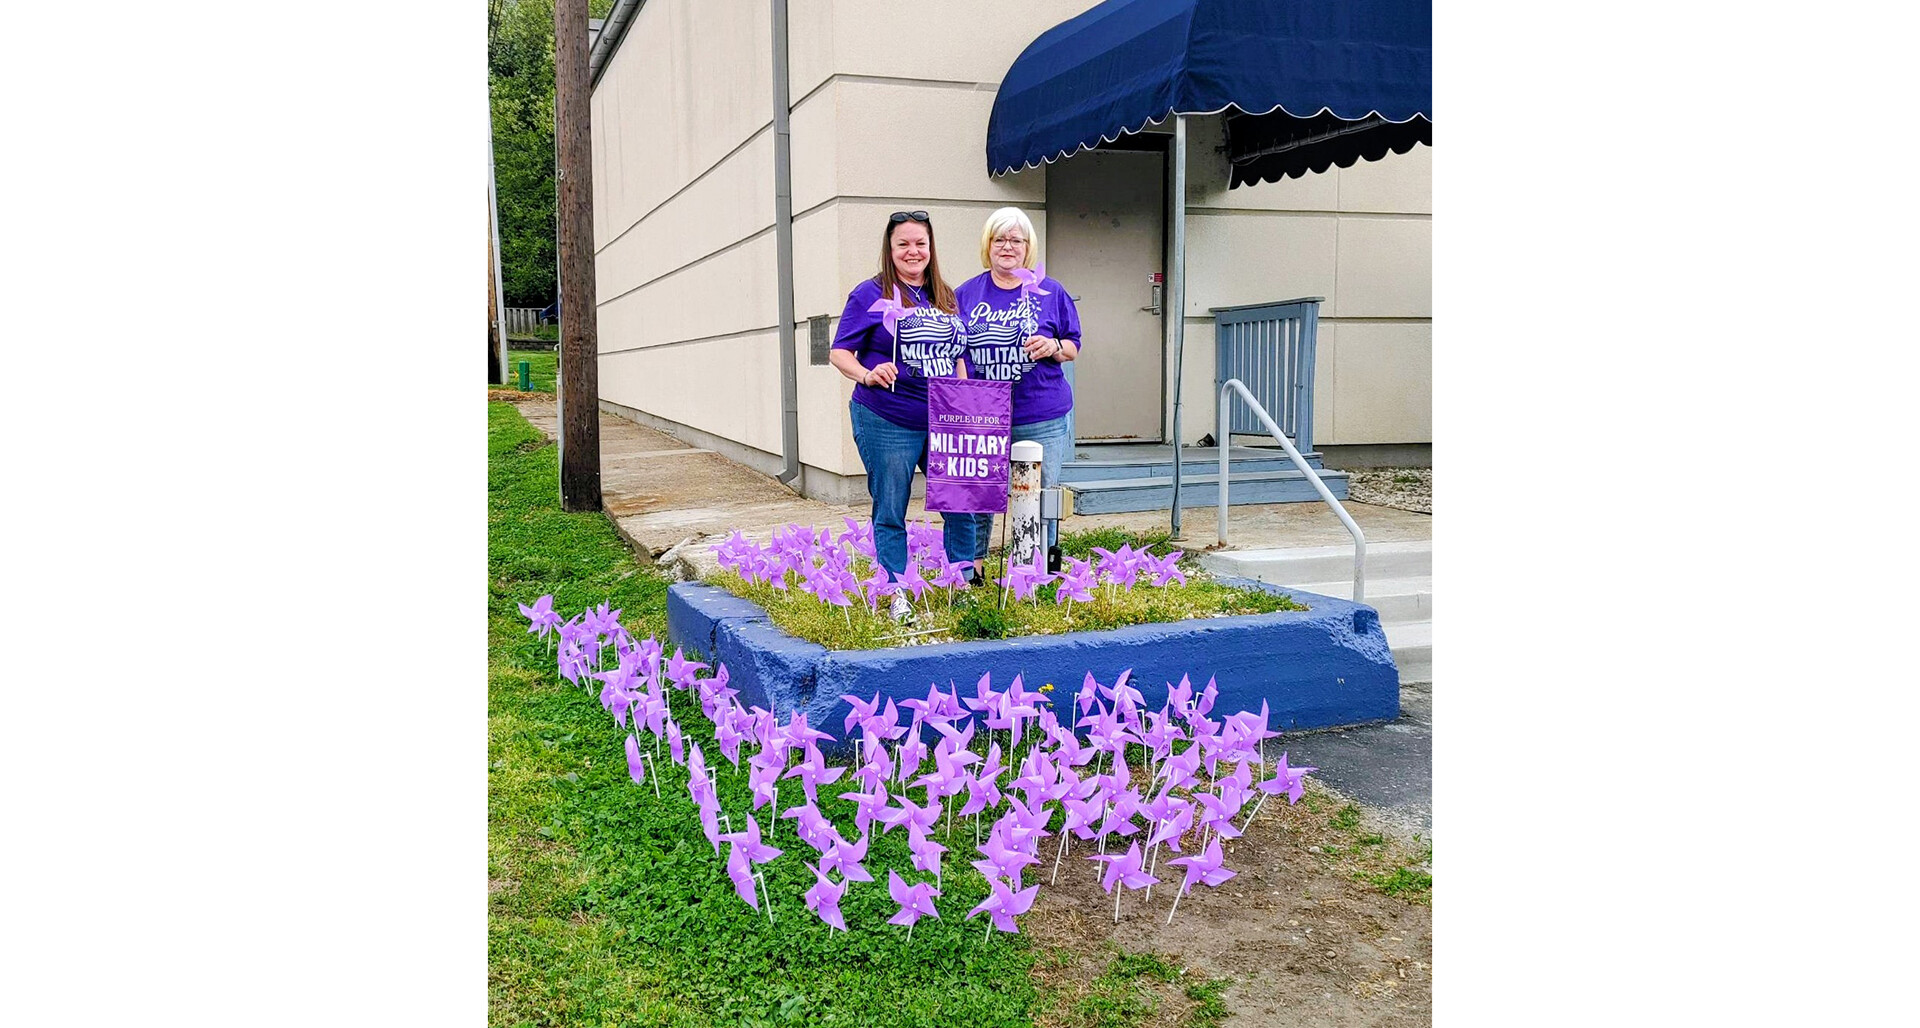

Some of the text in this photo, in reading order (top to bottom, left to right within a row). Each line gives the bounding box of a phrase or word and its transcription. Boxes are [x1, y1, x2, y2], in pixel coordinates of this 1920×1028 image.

[968, 302, 1033, 327] Purple
[922, 357, 953, 377] KIDS
[985, 363, 1021, 380] KIDS
[939, 414, 1000, 425] PURPLE UP FOR
[930, 432, 1008, 455] MILITARY
[947, 456, 989, 478] KIDS
